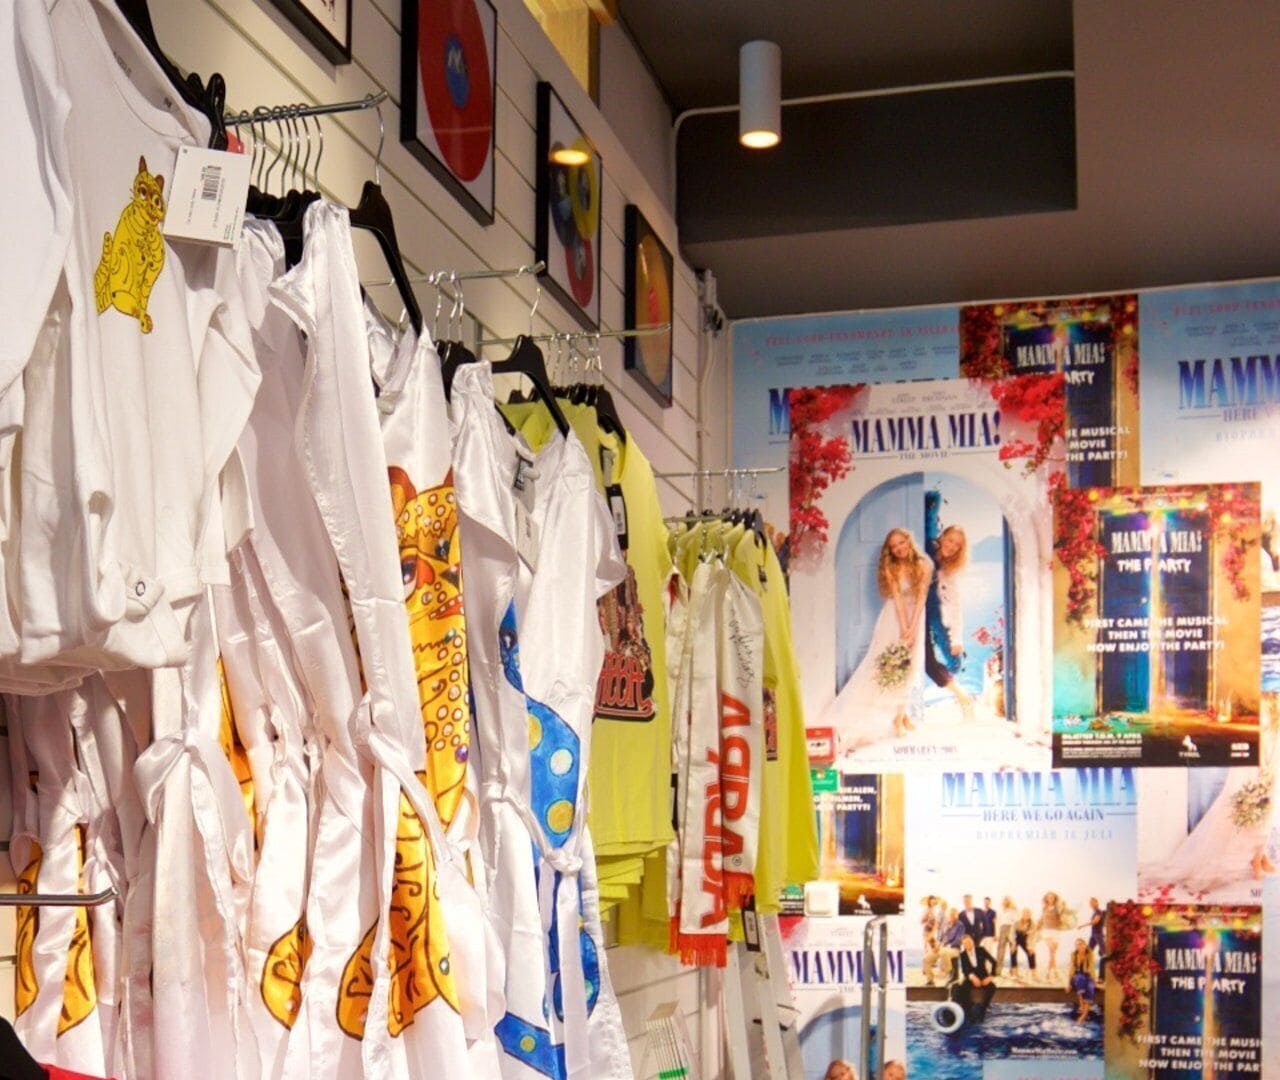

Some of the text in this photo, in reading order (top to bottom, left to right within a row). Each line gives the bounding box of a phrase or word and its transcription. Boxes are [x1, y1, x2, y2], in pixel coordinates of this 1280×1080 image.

[1063, 370, 1095, 385] ARTY
[852, 410, 1001, 453] MAMMA MIA!
[1070, 439, 1106, 450] MOVIE
[1111, 529, 1202, 554] MAMMA MIA!
[1117, 557, 1191, 573] THE PARTY
[1117, 617, 1149, 627] CAME
[1108, 630, 1138, 640] THEN
[1165, 628, 1202, 639] MOVIE
[1087, 643, 1116, 652] NOW
[1183, 639, 1225, 650] PARTY!
[942, 771, 1067, 807] MAMMA
[983, 809, 1105, 821] HERE WE GO AGAIN
[1165, 948, 1222, 973] MAMMA
[1171, 976, 1196, 990] THE
[1170, 1035, 1202, 1046] CAME
[1230, 1038, 1261, 1048] MUSI
[1161, 1048, 1191, 1058] THEN
[1218, 1050, 1257, 1060] MOVIE
[1139, 1059, 1169, 1069] NOW
[1237, 1061, 1261, 1072] PAR
